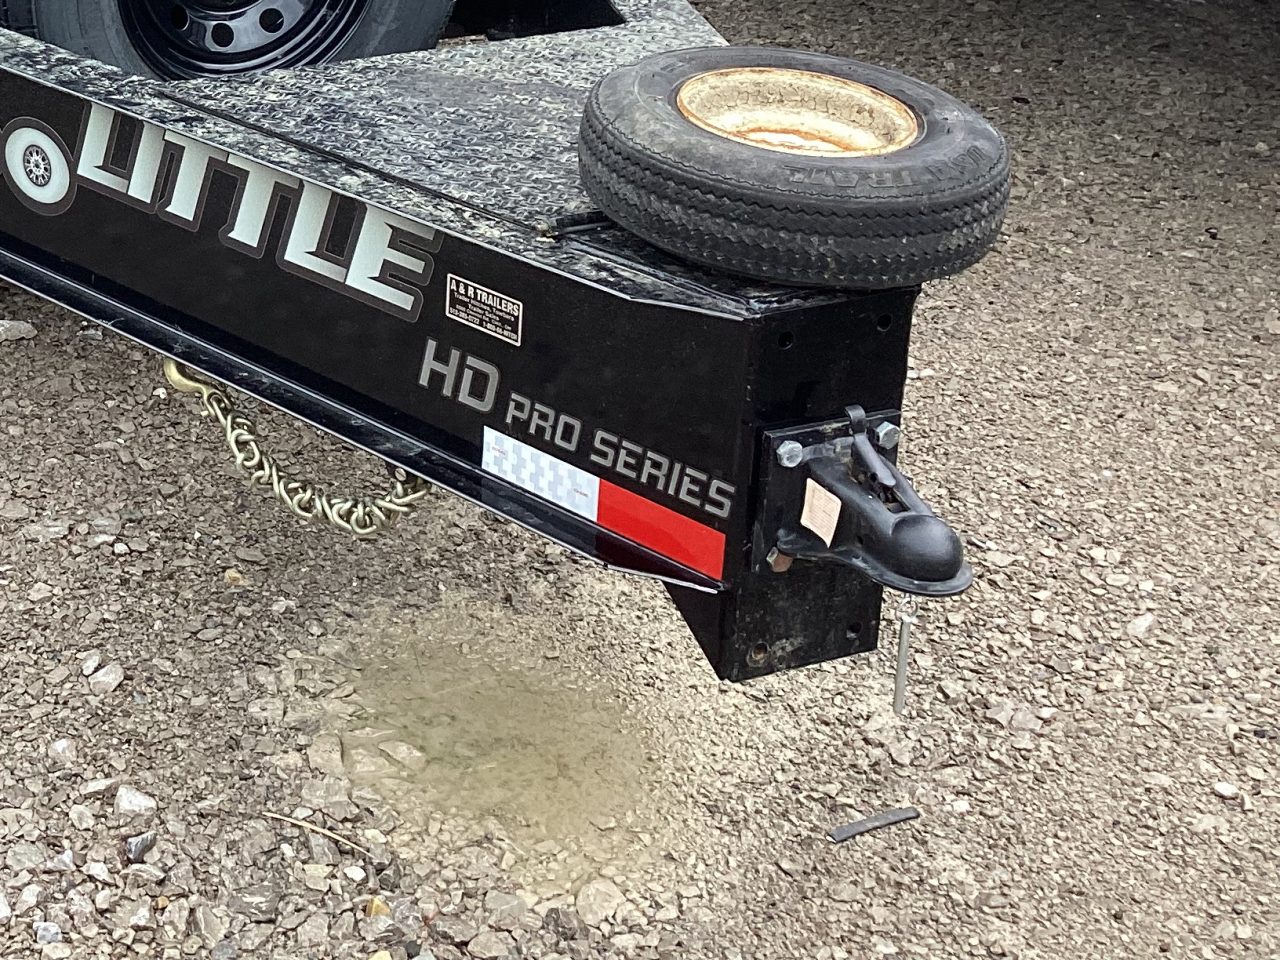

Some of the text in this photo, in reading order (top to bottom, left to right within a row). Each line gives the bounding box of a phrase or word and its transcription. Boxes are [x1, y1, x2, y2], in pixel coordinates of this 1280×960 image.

[450, 279, 457, 291] A
[458, 282, 466, 295] &
[467, 285, 475, 299] R
[476, 289, 519, 317] TRAILERS
[419, 339, 500, 413] HD
[505, 392, 582, 452] PRO
[590, 430, 736, 519] SERIES
